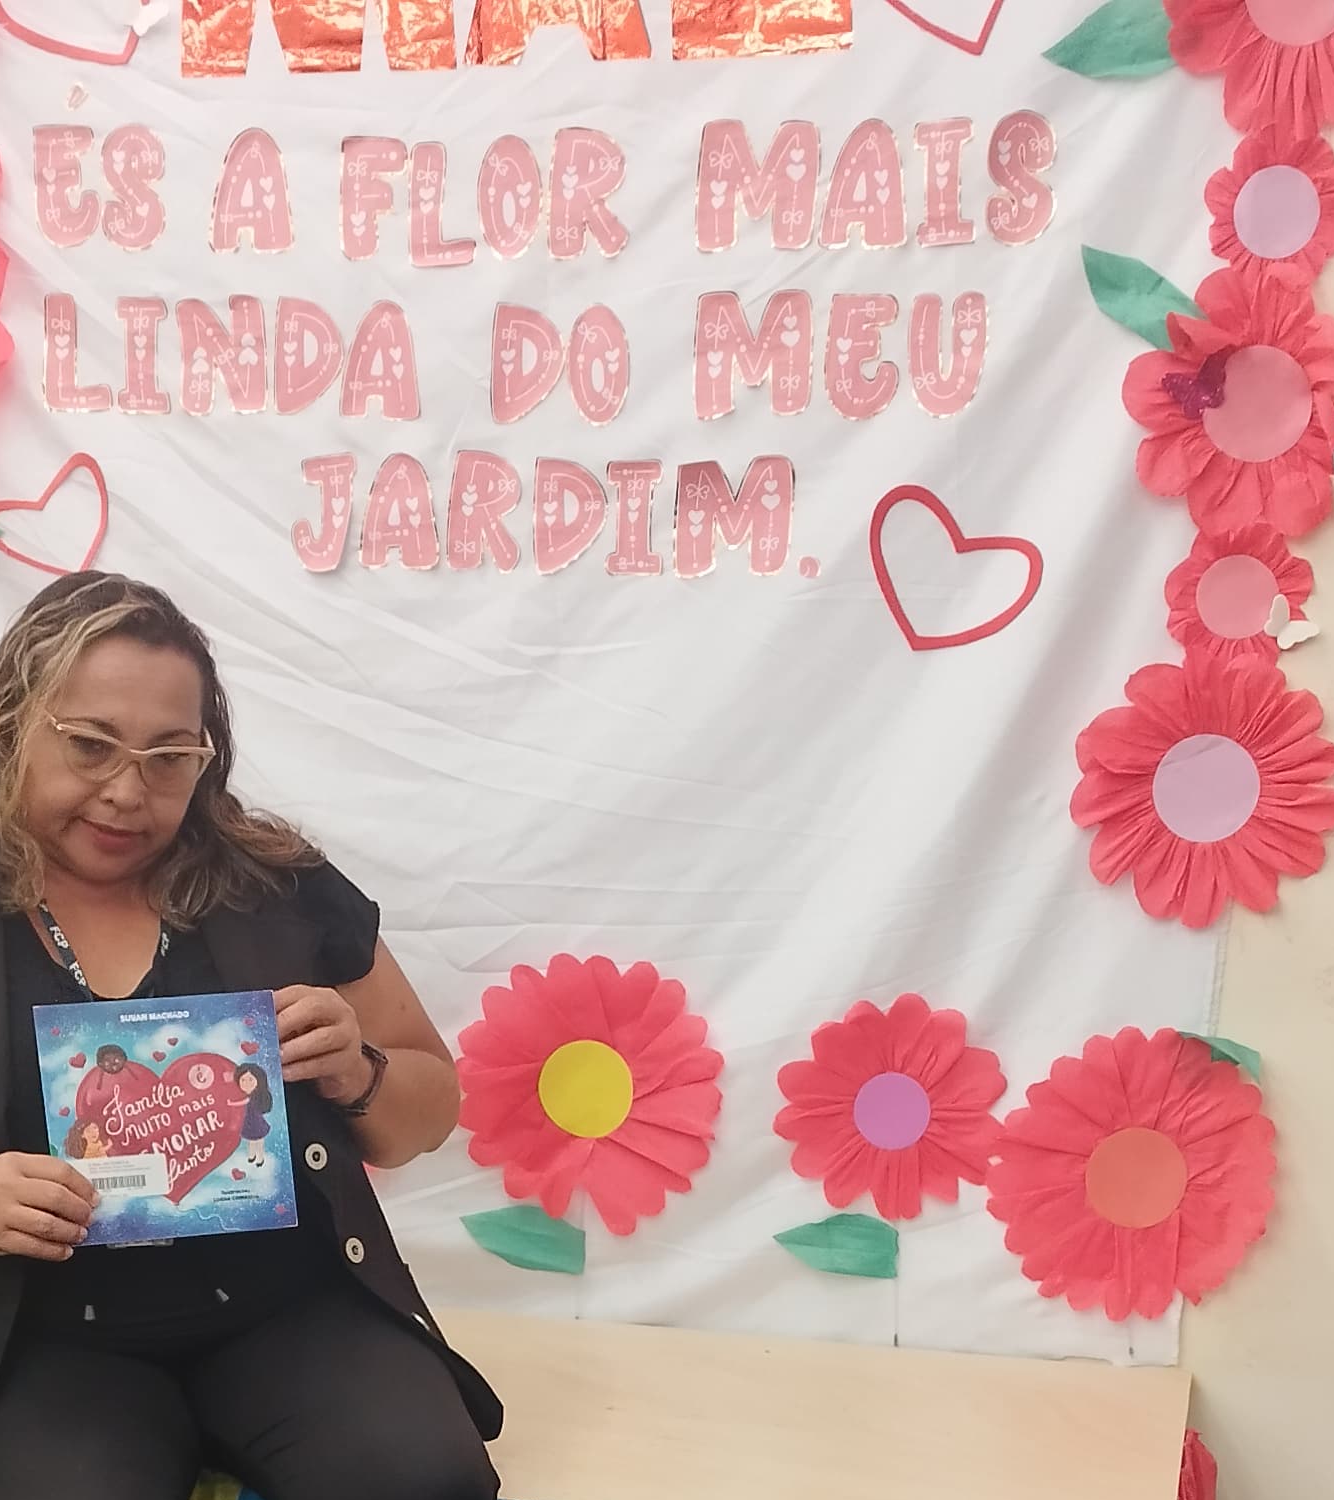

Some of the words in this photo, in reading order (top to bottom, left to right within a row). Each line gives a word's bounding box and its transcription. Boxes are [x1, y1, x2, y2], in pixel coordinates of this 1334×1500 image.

[209, 126, 295, 253] A
[340, 126, 629, 268] FLOR
[694, 108, 1057, 253] MAIS
[41, 291, 422, 420] LINDA
[489, 301, 631, 425] DO
[694, 289, 991, 420] MEU
[291, 449, 823, 579] JARDIM.
[49, 925, 69, 950] FCP
[122, 1112, 171, 1146] MUITO
[178, 1093, 215, 1117] mais
[152, 1110, 224, 1156] MORAR
